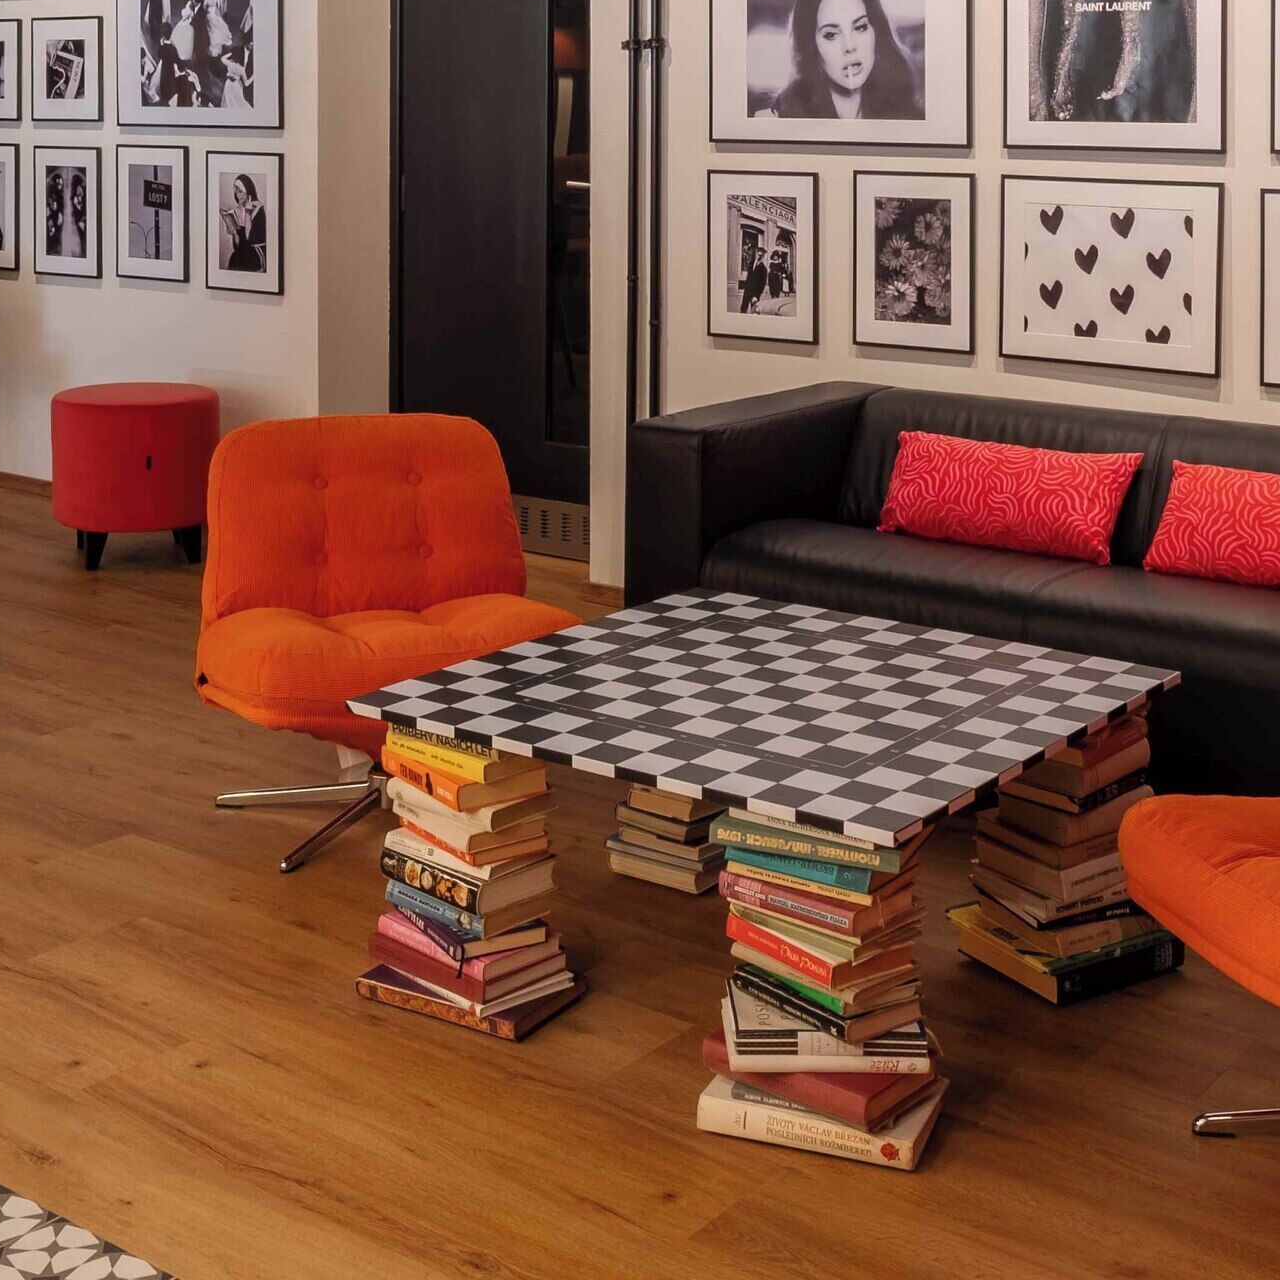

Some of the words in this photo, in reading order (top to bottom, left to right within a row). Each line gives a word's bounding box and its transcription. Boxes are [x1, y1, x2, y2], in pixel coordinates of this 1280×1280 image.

[1075, 1, 1105, 12] SAINT
[1105, 1, 1152, 12] LAURENT
[766, 1115, 797, 1130] ŽIVOTY
[798, 1119, 832, 1137] VÁCLAV
[766, 1126, 817, 1145] POSLEDNÍCH
